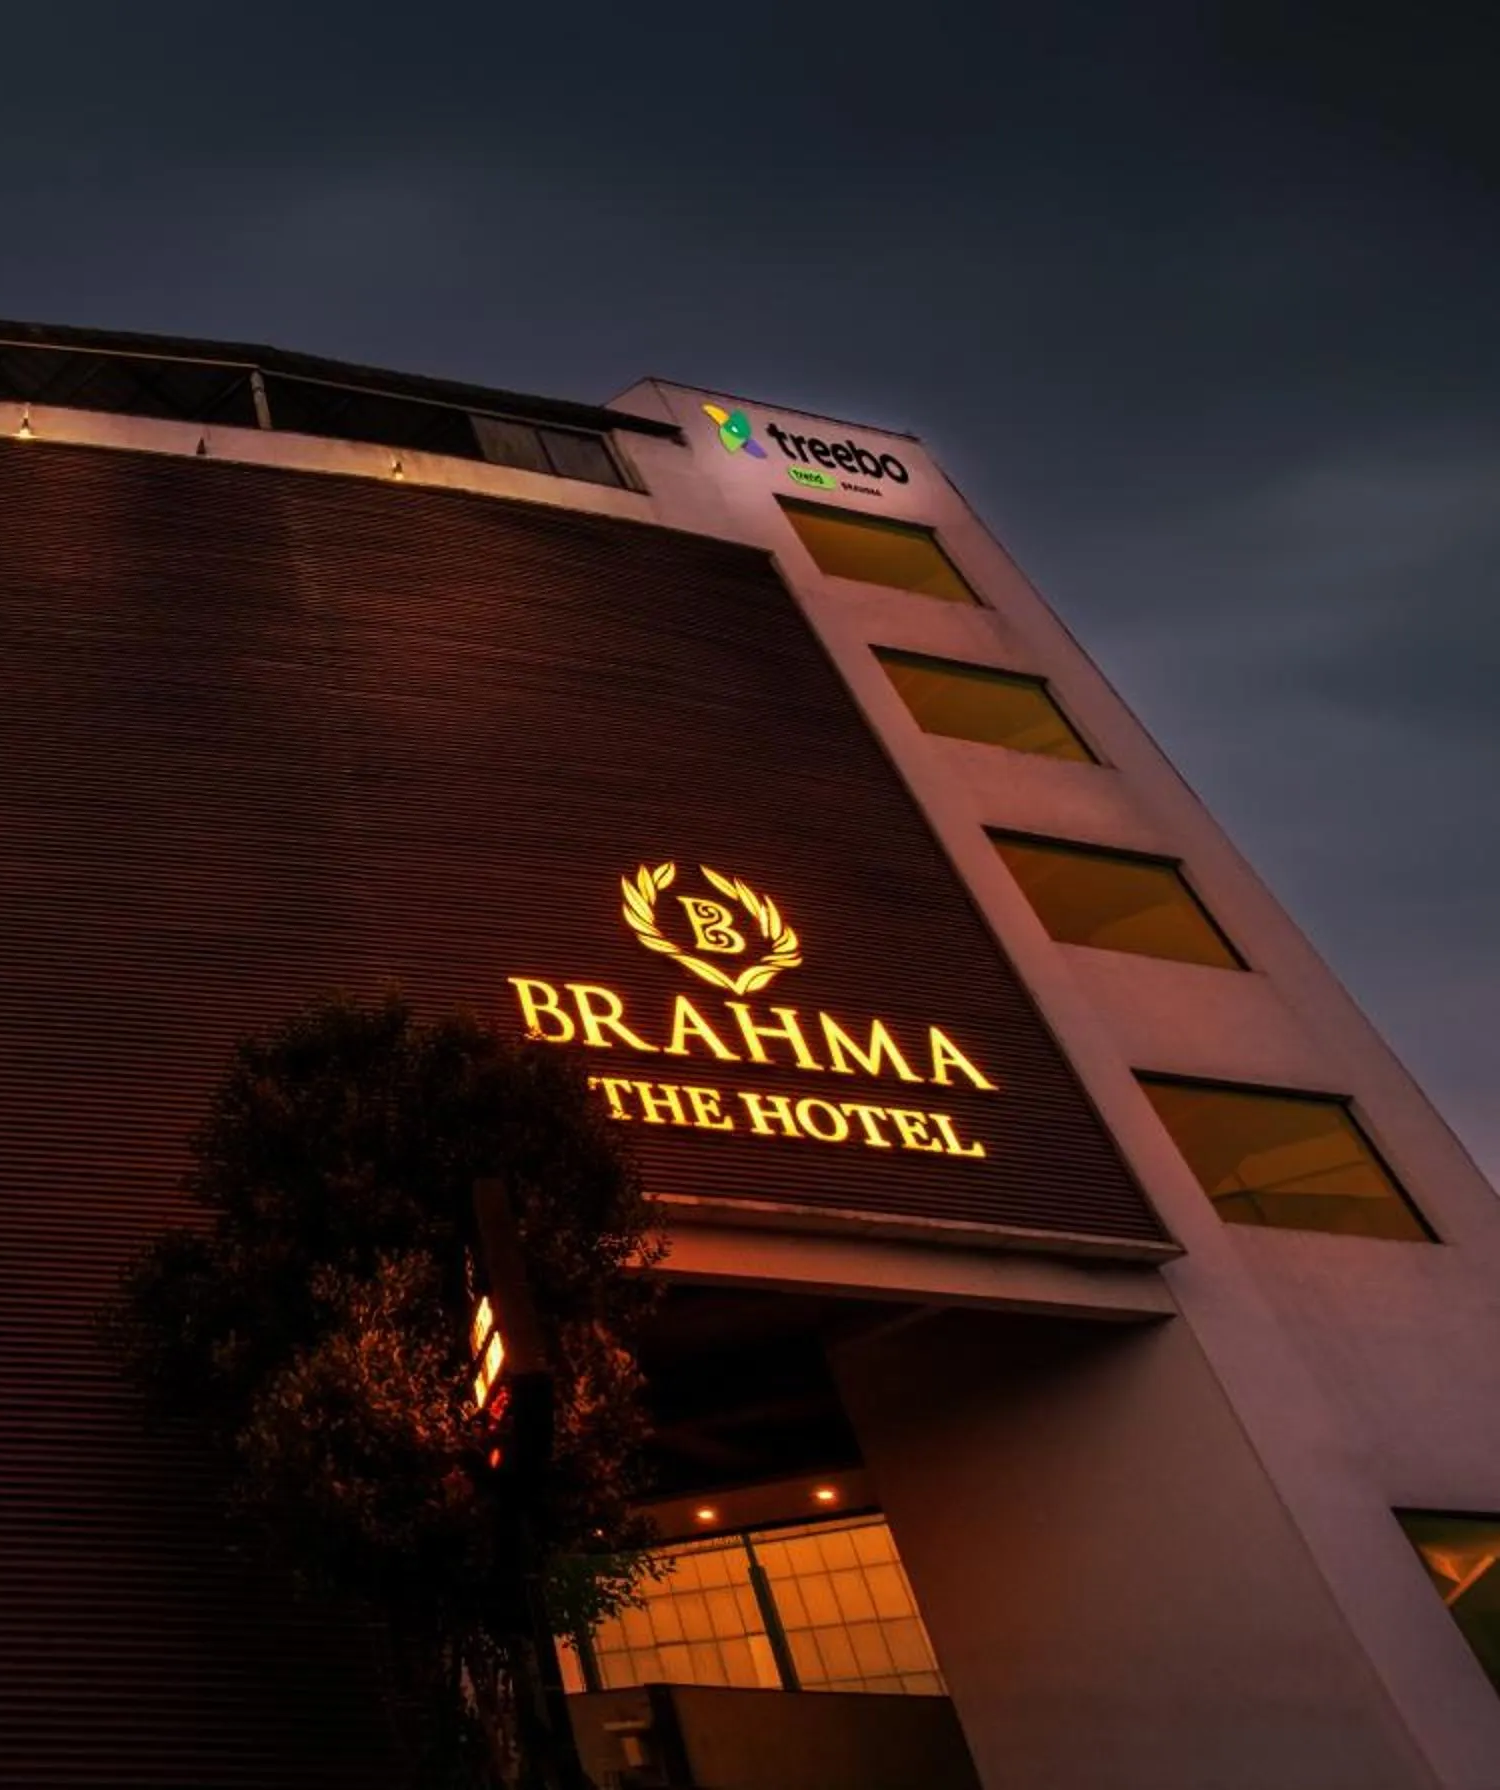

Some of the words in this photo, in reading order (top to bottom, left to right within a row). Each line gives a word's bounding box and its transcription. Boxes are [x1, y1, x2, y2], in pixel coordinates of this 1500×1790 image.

[766, 422, 909, 484] treebo
[677, 895, 746, 954] B
[507, 976, 999, 1090] BRAHMA
[587, 1076, 735, 1131] THE
[737, 1092, 986, 1158] HOTEL
